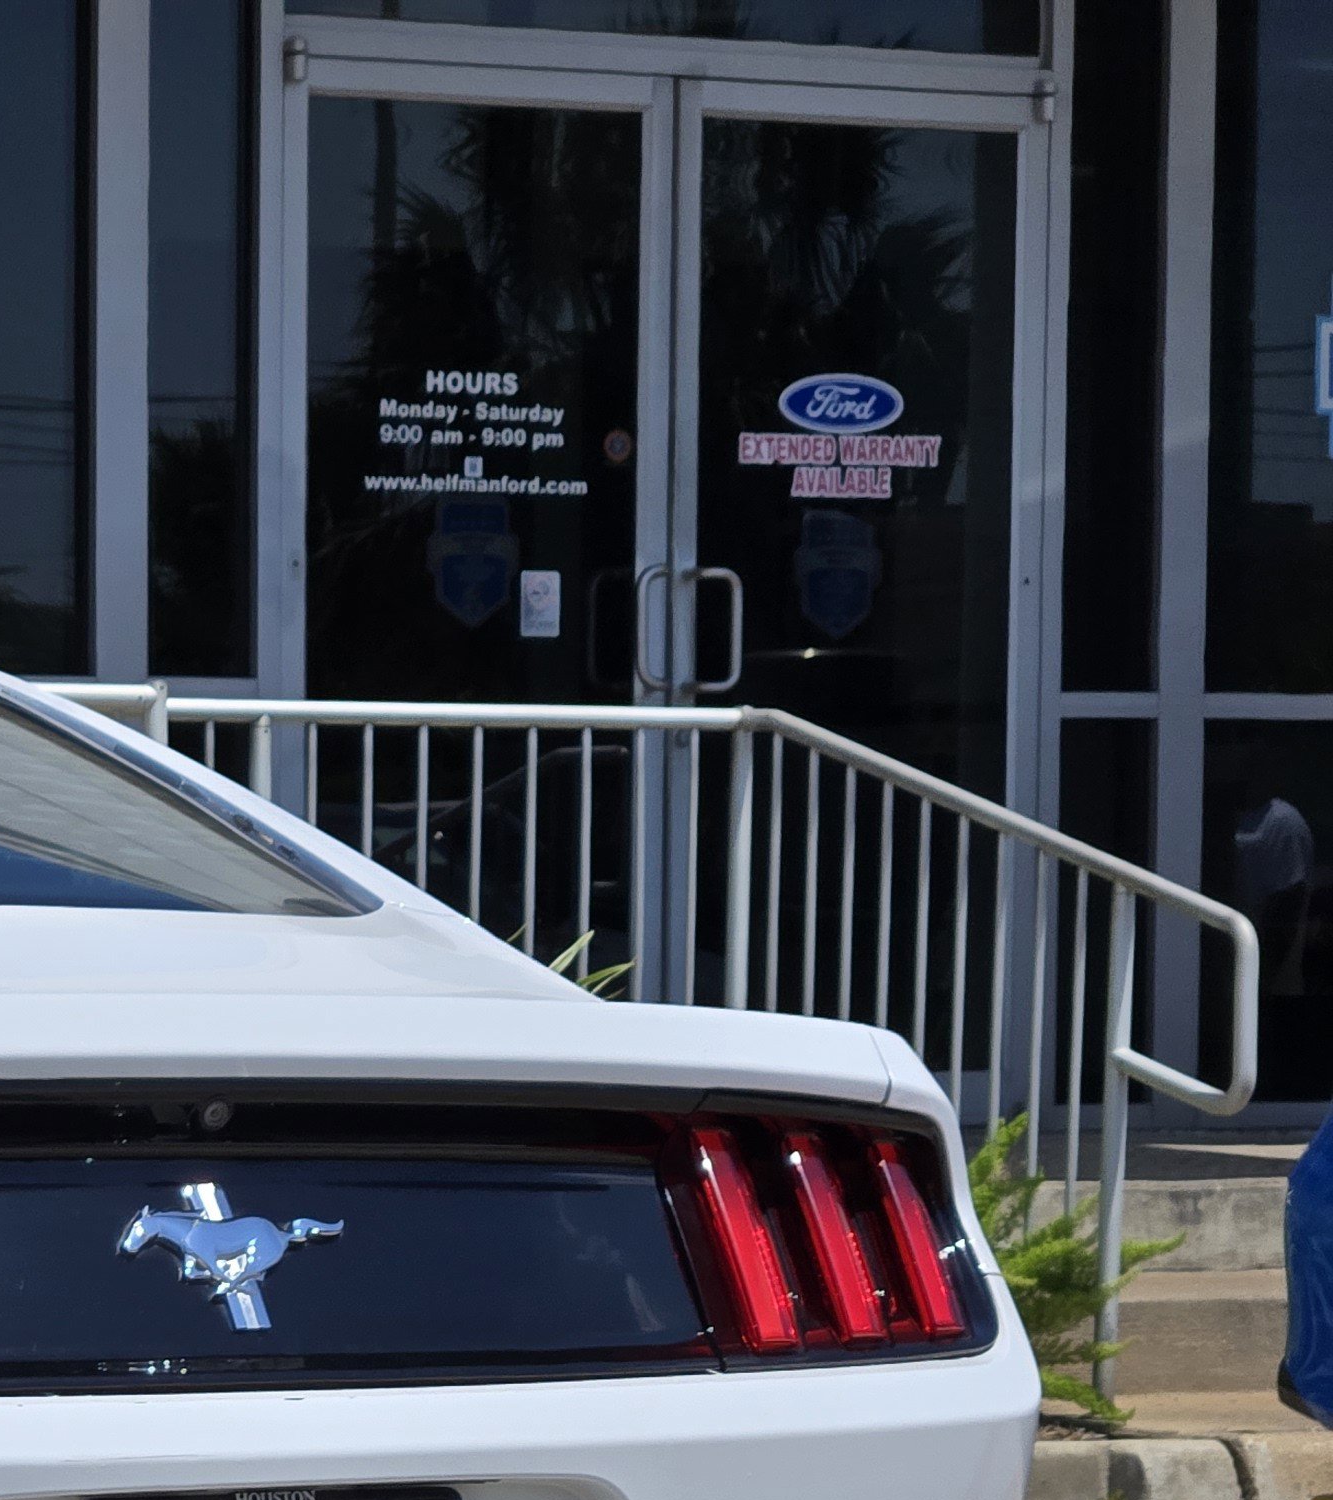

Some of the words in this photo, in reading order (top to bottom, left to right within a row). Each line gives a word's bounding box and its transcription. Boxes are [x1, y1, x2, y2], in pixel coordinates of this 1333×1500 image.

[425, 369, 520, 396] HOURS
[379, 398, 459, 425] Monday
[475, 401, 565, 428] Saturday
[806, 384, 878, 420] Ford
[379, 423, 424, 445] 9:00
[430, 429, 464, 446] am
[481, 427, 527, 448] 9:00
[532, 431, 565, 452] pm
[739, 433, 836, 464] EXTENDED
[839, 435, 940, 466] WARRANTY
[364, 473, 588, 495] www.helfmanford.com
[792, 467, 891, 498] AVAILABLE
